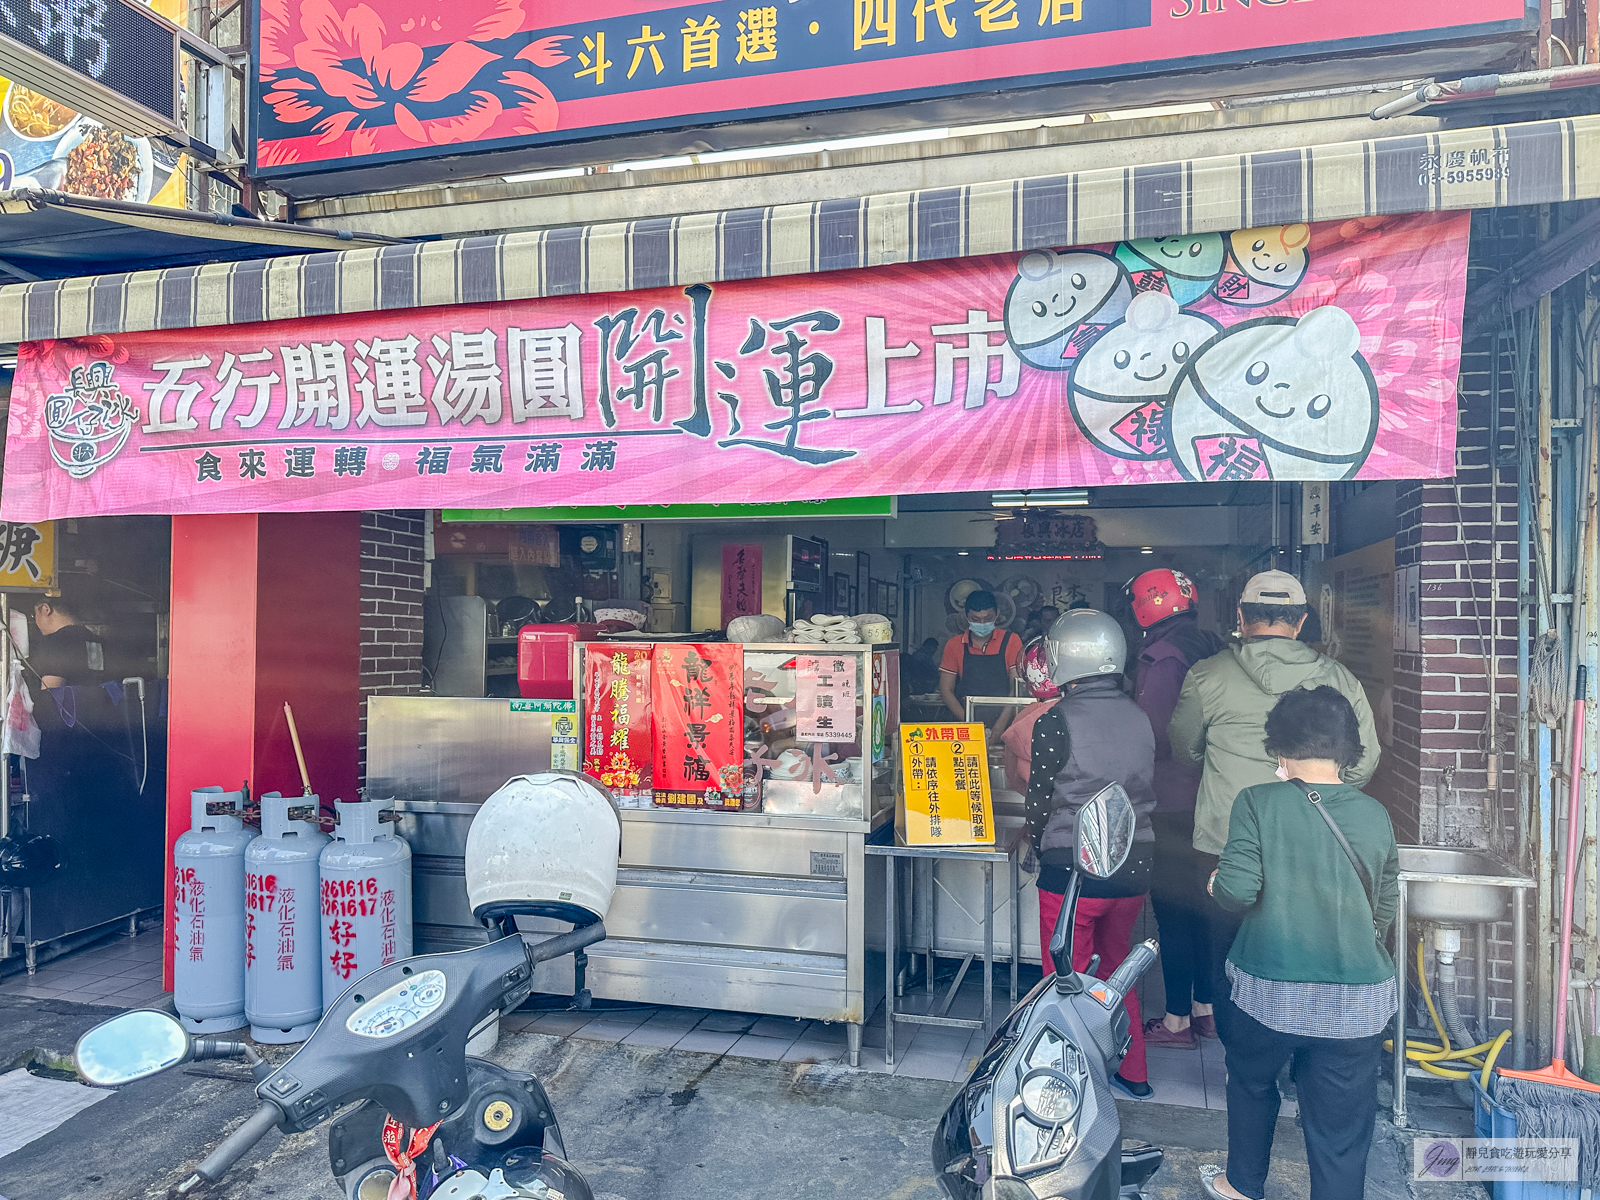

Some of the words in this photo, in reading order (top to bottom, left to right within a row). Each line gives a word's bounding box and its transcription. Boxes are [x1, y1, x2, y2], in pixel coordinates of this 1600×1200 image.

[1426, 584, 1442, 592] 136
[925, 727, 970, 741] 外帶區
[189, 879, 205, 962] 液化石油氣
[277, 888, 296, 971] 液化石油氣
